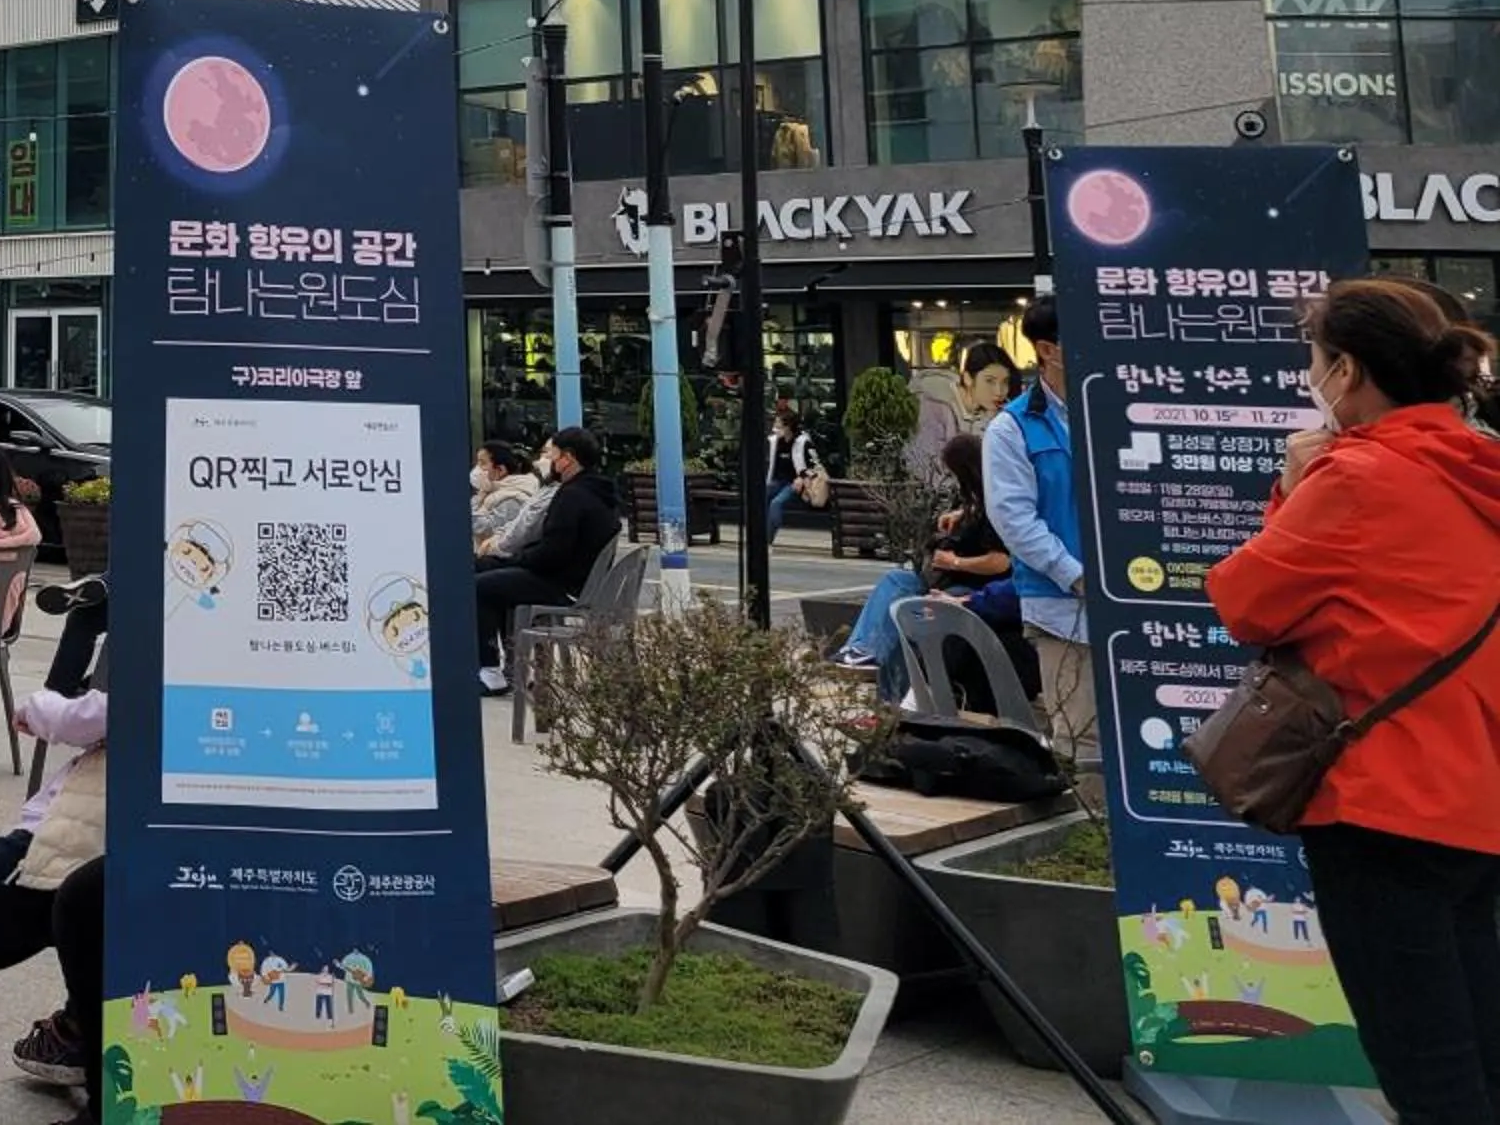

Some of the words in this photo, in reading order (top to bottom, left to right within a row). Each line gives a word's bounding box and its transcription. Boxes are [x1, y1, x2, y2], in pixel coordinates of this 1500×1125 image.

[10, 144, 38, 217] 임대
[683, 190, 974, 244] BLACKYAK
[169, 220, 240, 259] 문화
[247, 223, 344, 265] 향유의
[352, 229, 418, 268] 공간
[1096, 266, 1158, 296] 문화
[1165, 268, 1259, 298] 향유의
[1267, 269, 1332, 299] 공간
[231, 366, 341, 389] 구)코리아극장
[344, 369, 363, 390] 앞
[1115, 364, 1186, 394] 탐나는
[1219, 436, 1271, 454] 상점가
[188, 456, 298, 492] QR찍고
[302, 458, 403, 494] 서로안심
[1171, 455, 1217, 473] 3만원
[1219, 456, 1253, 473] 이상
[1142, 620, 1203, 648] 탐나는
[177, 864, 217, 888] Jeju
[230, 866, 319, 885] 제주특별자치도
[368, 874, 436, 890] 제주관광공사
